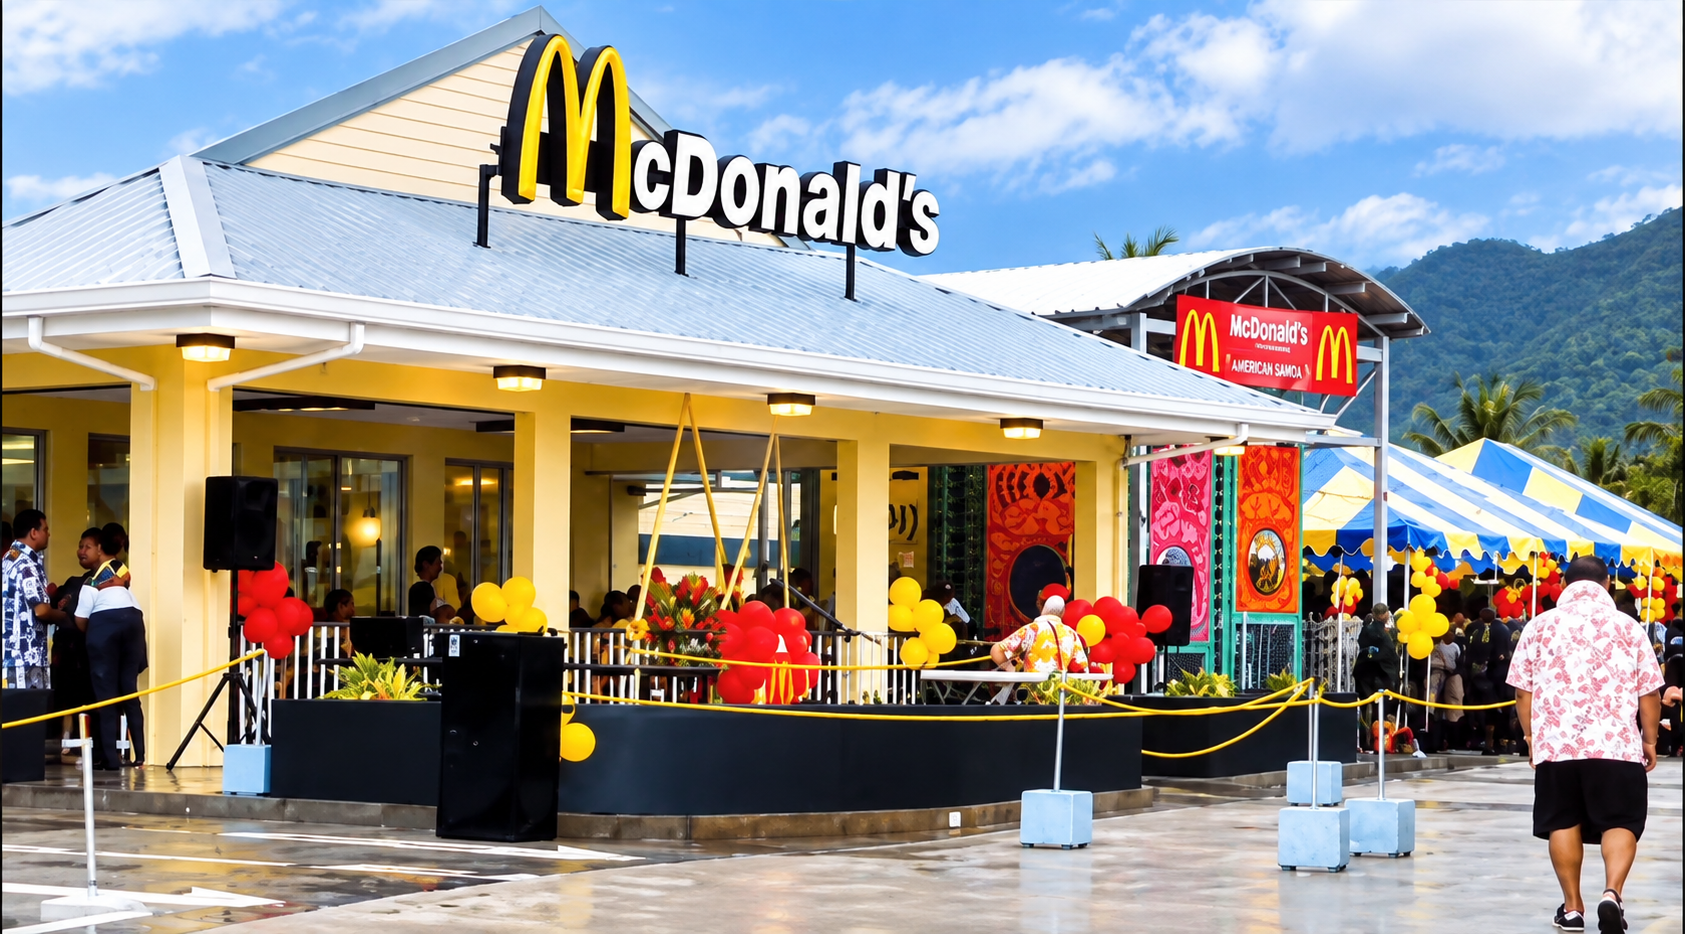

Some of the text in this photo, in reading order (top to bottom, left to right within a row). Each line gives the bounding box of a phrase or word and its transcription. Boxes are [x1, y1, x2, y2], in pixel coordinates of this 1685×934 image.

[508, 34, 940, 257] McDonald's
[1229, 314, 1308, 345] McDonald's
[1274, 363, 1302, 379] SAMOA
